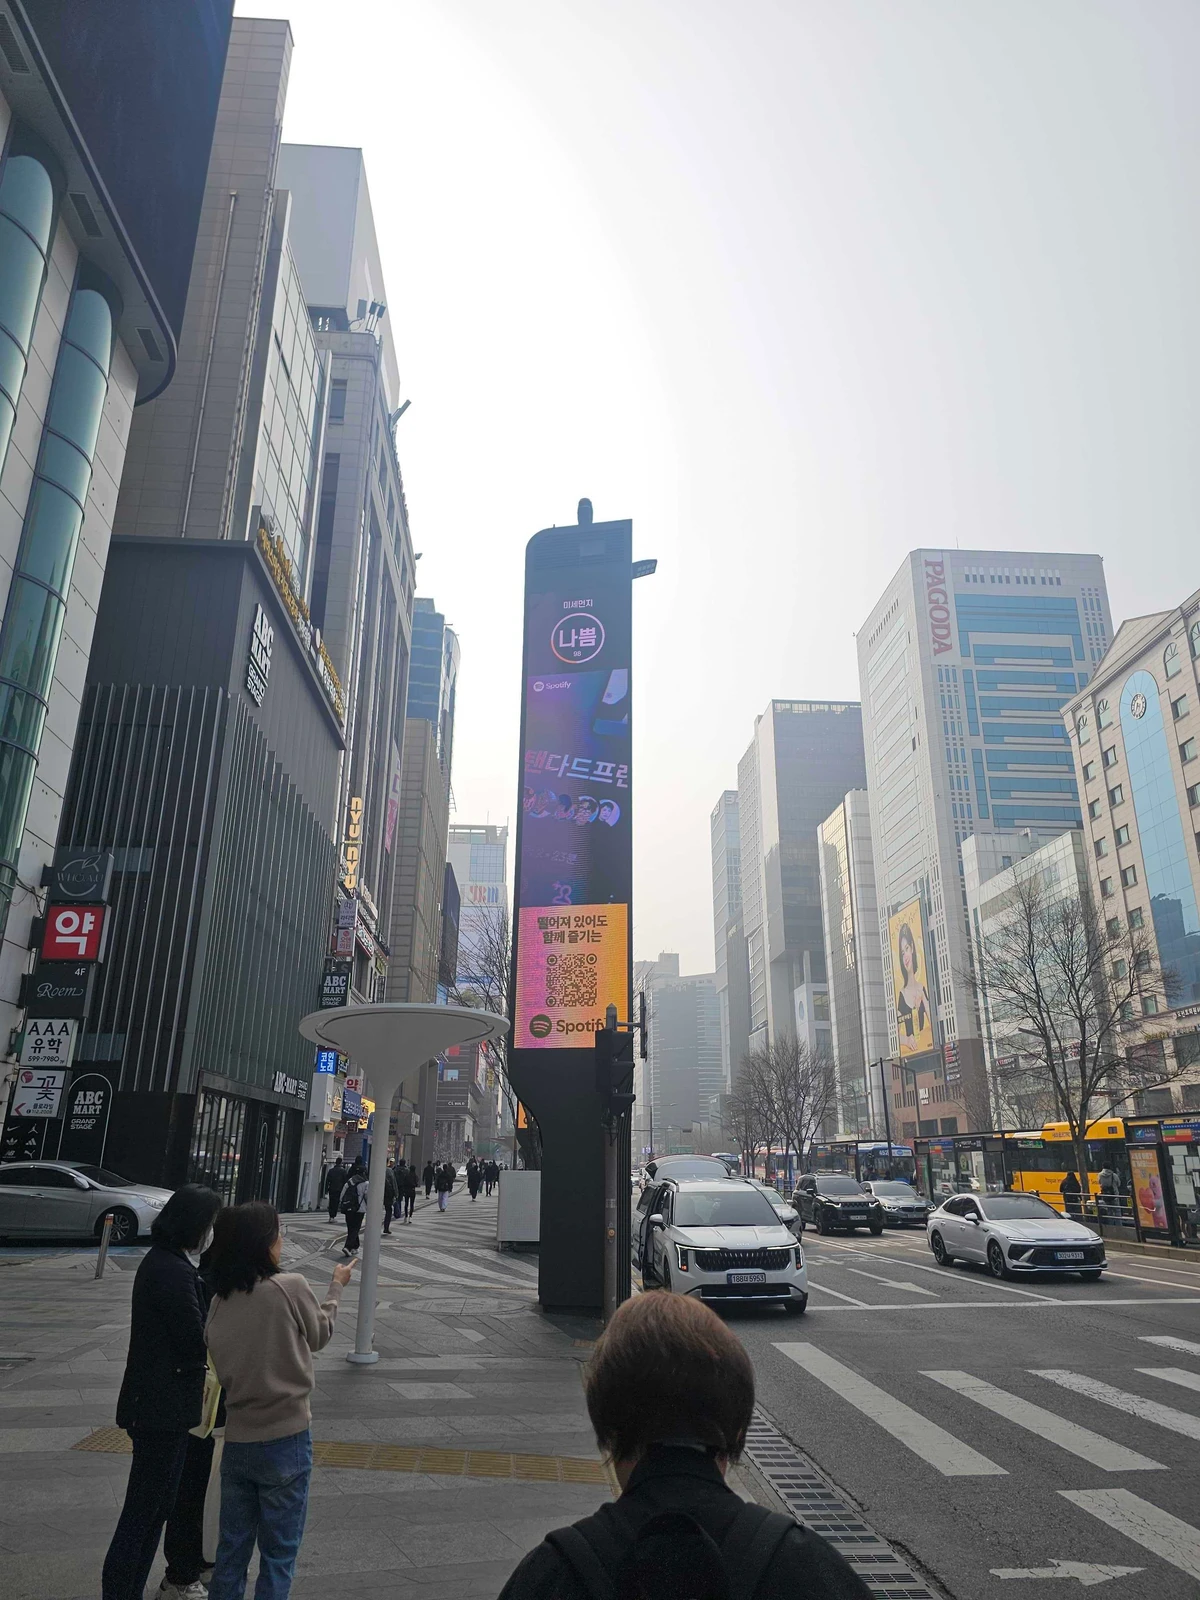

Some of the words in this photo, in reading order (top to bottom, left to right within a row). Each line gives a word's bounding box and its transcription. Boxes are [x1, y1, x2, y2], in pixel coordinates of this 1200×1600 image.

[563, 599, 593, 609] 미세먼지
[924, 559, 953, 656] PAGODA
[254, 603, 274, 657] ABC
[559, 627, 597, 648] 나쁨
[251, 631, 271, 679] MART
[546, 681, 572, 690] Spotify
[537, 915, 571, 929] 떨어져
[574, 915, 608, 929] 있어도
[55, 910, 96, 955] 약
[542, 930, 565, 944] 함께
[567, 929, 602, 944] 즐기는
[74, 967, 86, 976] 4F
[324, 976, 347, 986] ABC
[36, 982, 84, 998] Roem
[323, 986, 346, 994] MART
[31, 1038, 63, 1054] 유학
[321, 1052, 335, 1062] 코인
[319, 1062, 334, 1072] 노래
[74, 1091, 104, 1105] ABC
[72, 1105, 102, 1115] MART
